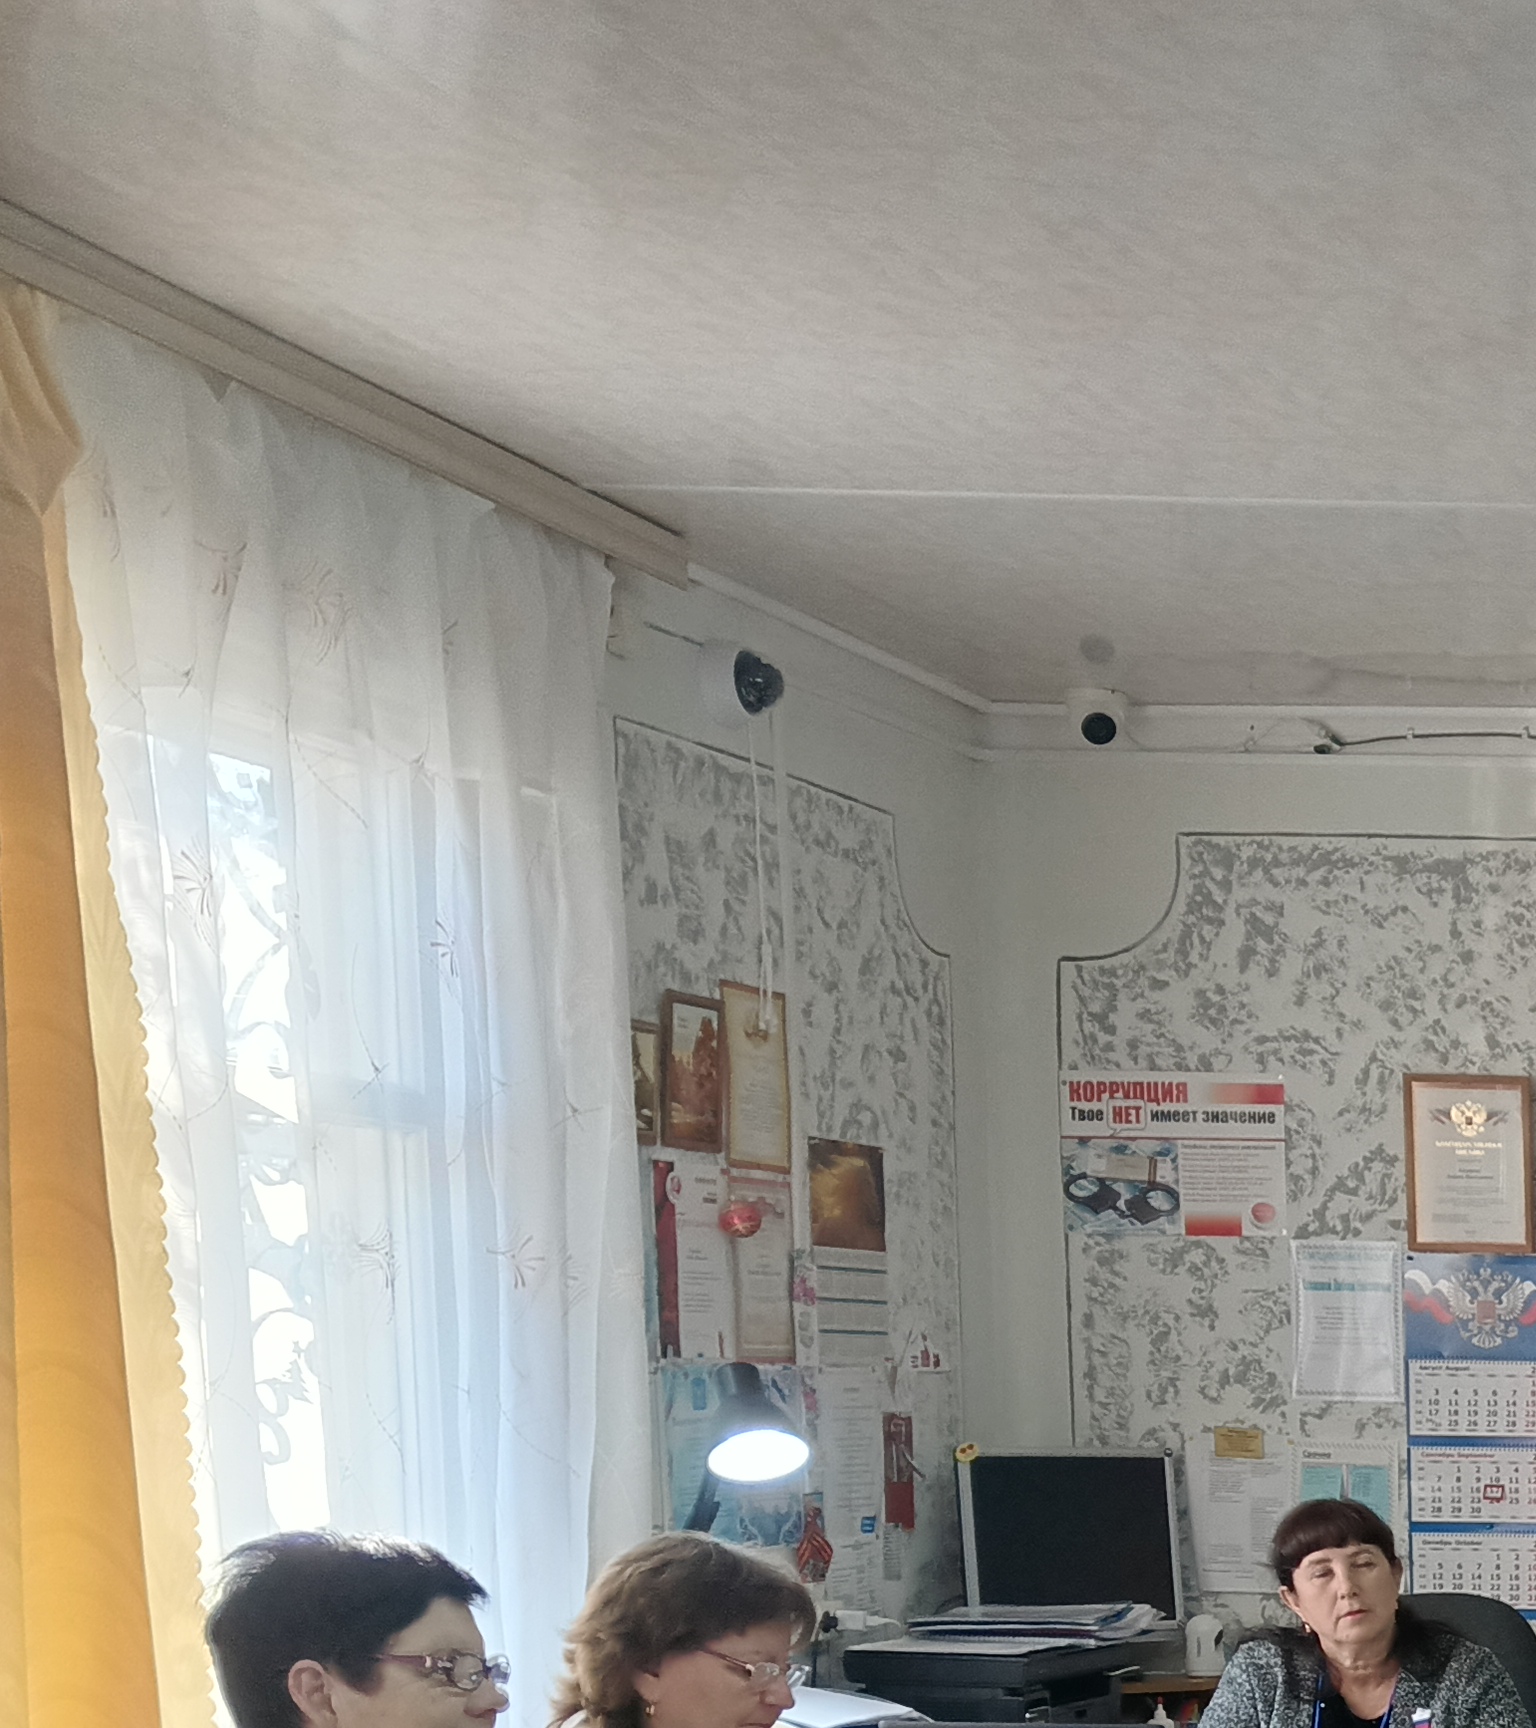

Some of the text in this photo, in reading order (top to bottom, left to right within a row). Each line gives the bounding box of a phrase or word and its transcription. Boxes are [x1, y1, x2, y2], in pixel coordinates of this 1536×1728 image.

[1068, 1080, 1188, 1105] КОРРУПЦИЯ
[1070, 1105, 1276, 1125] Твое НЕТ имеет значение
[1428, 1398, 1440, 1406] 10
[1467, 1399, 1478, 1407] 12
[1487, 1399, 1498, 1407] 13
[1429, 1408, 1439, 1416] 17
[1468, 1409, 1478, 1417] 19
[1486, 1409, 1498, 1417] 20
[1506, 1410, 1517, 1418] 21
[1525, 1410, 1536, 1418] 22
[1448, 1419, 1459, 1427] 25
[1506, 1420, 1517, 1428] 28
[1525, 1420, 1536, 1428] 29
[1450, 1496, 1462, 1504] 22
[1470, 1496, 1481, 1504] 23
[1509, 1497, 1520, 1505] 25
[1470, 1506, 1482, 1514] 30
[1433, 1572, 1443, 1580] 12
[1490, 1573, 1501, 1581] 15
[1472, 1583, 1482, 1591] 21
[1490, 1583, 1501, 1591] 22
